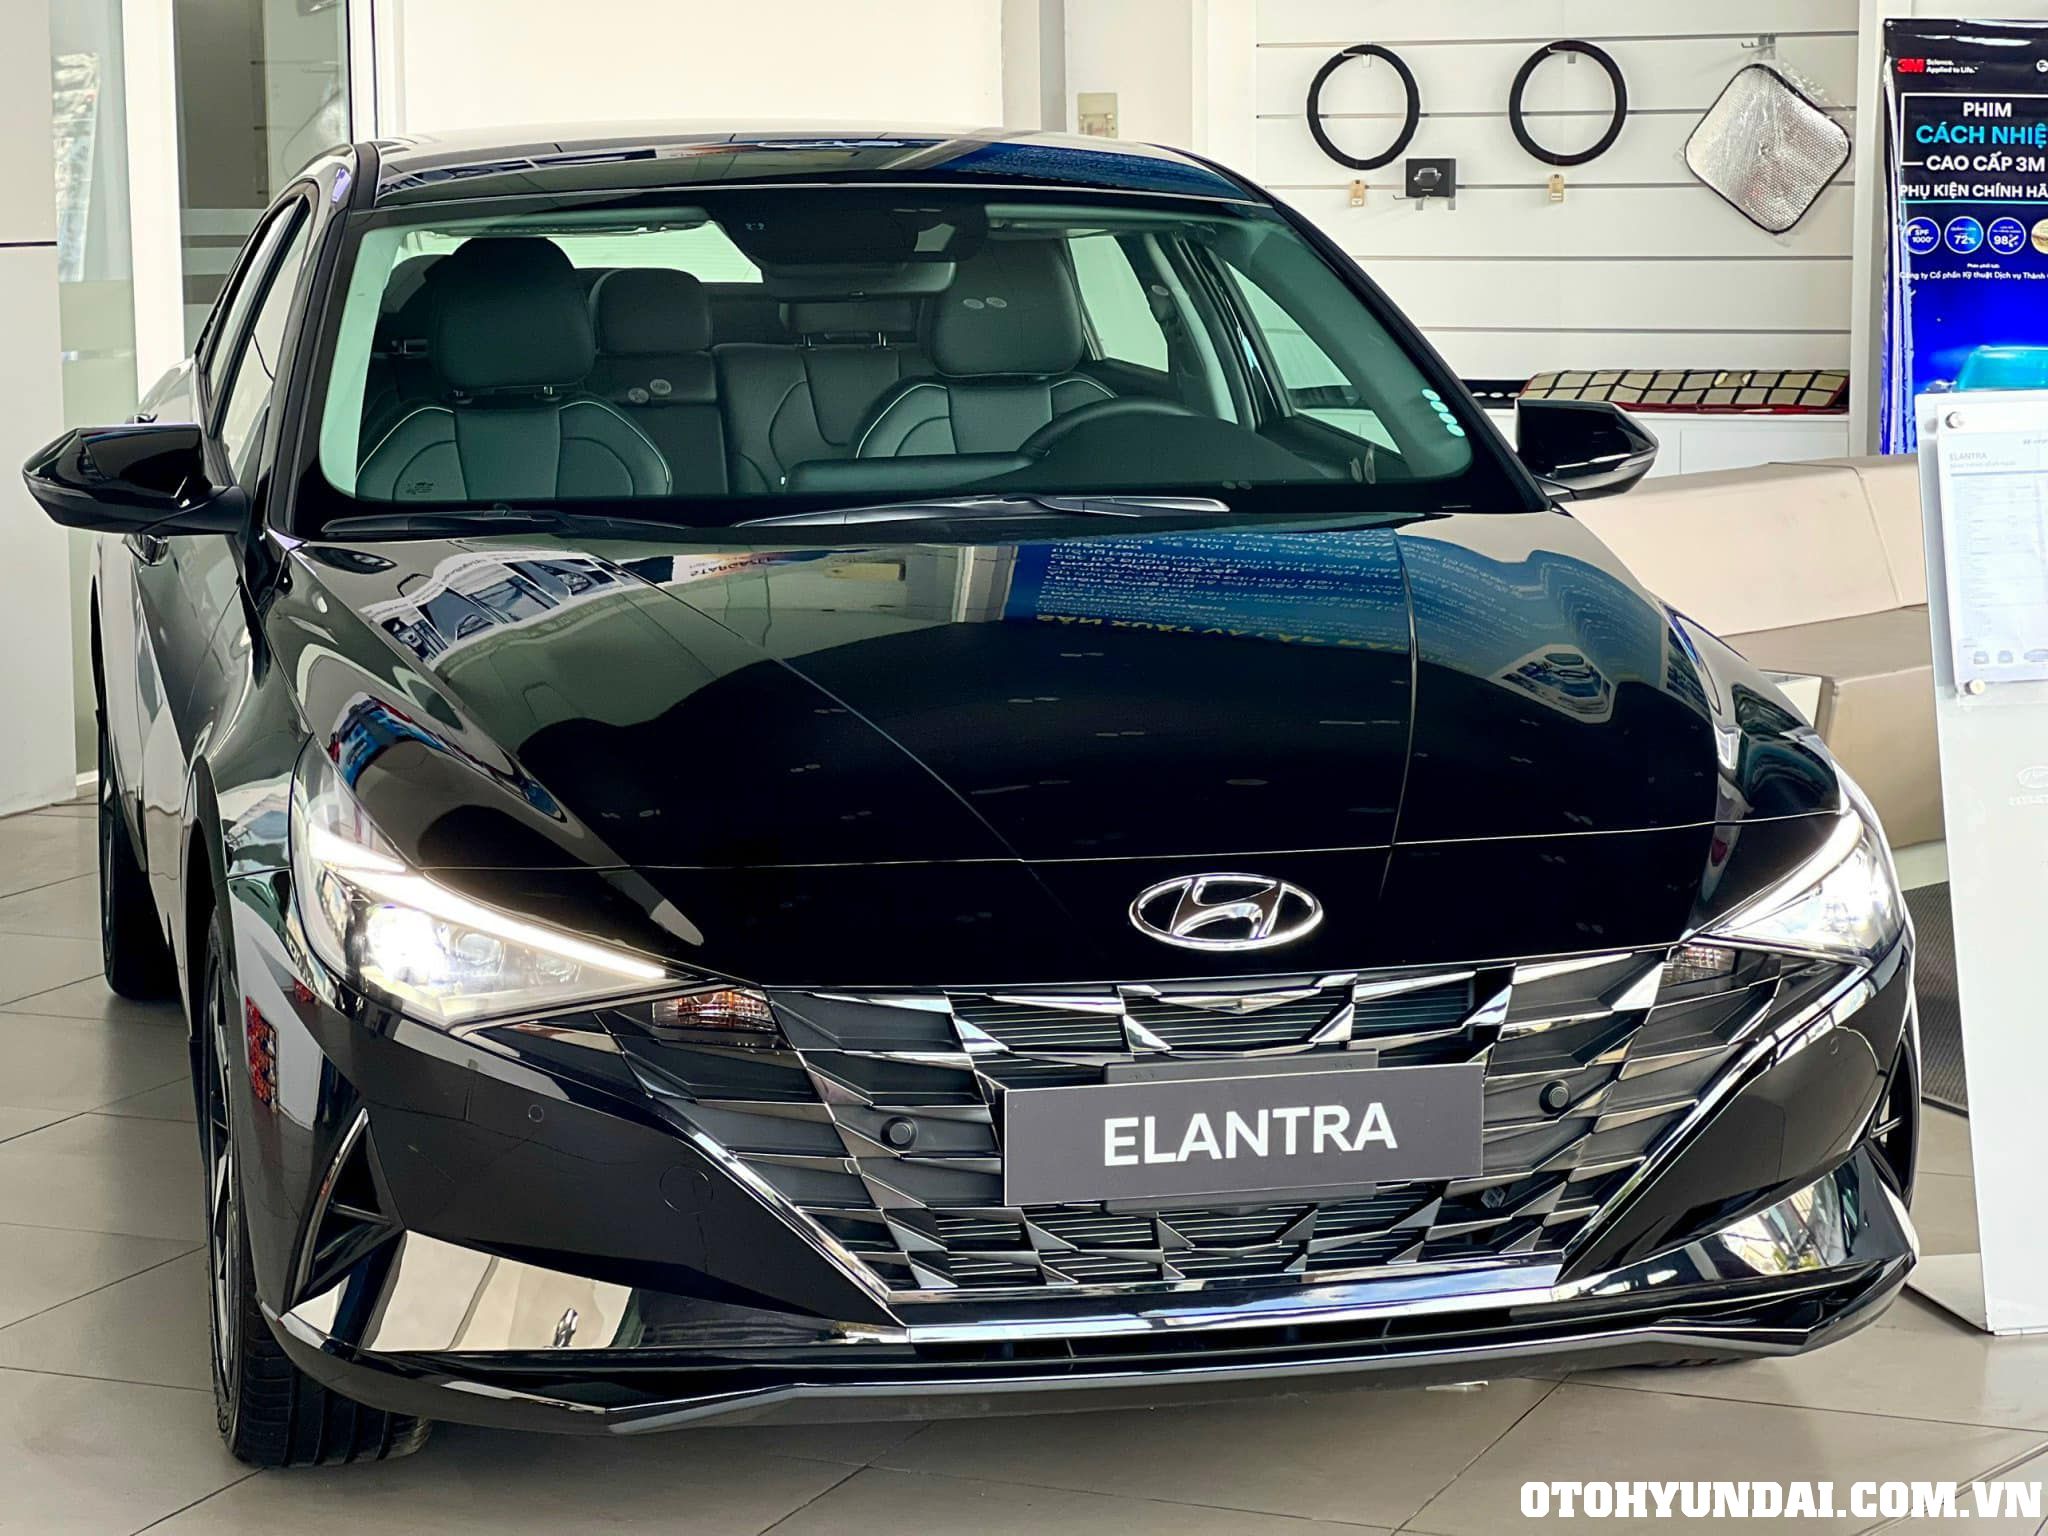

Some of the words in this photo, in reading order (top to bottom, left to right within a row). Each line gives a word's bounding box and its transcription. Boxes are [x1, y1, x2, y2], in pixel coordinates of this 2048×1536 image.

[1897, 59, 1925, 73] 3M
[1963, 102, 2012, 117] PHIM
[1916, 122, 1985, 144] CÁCH
[1926, 155, 1970, 171] CAO
[1973, 152, 2013, 171] CẤP
[2016, 157, 2045, 172] 3M
[1900, 184, 1930, 200] PHỤ
[1934, 181, 1969, 199] KIỆN
[1972, 182, 2022, 198] CHÍNH
[1104, 1101, 1398, 1167] ELANTRA
